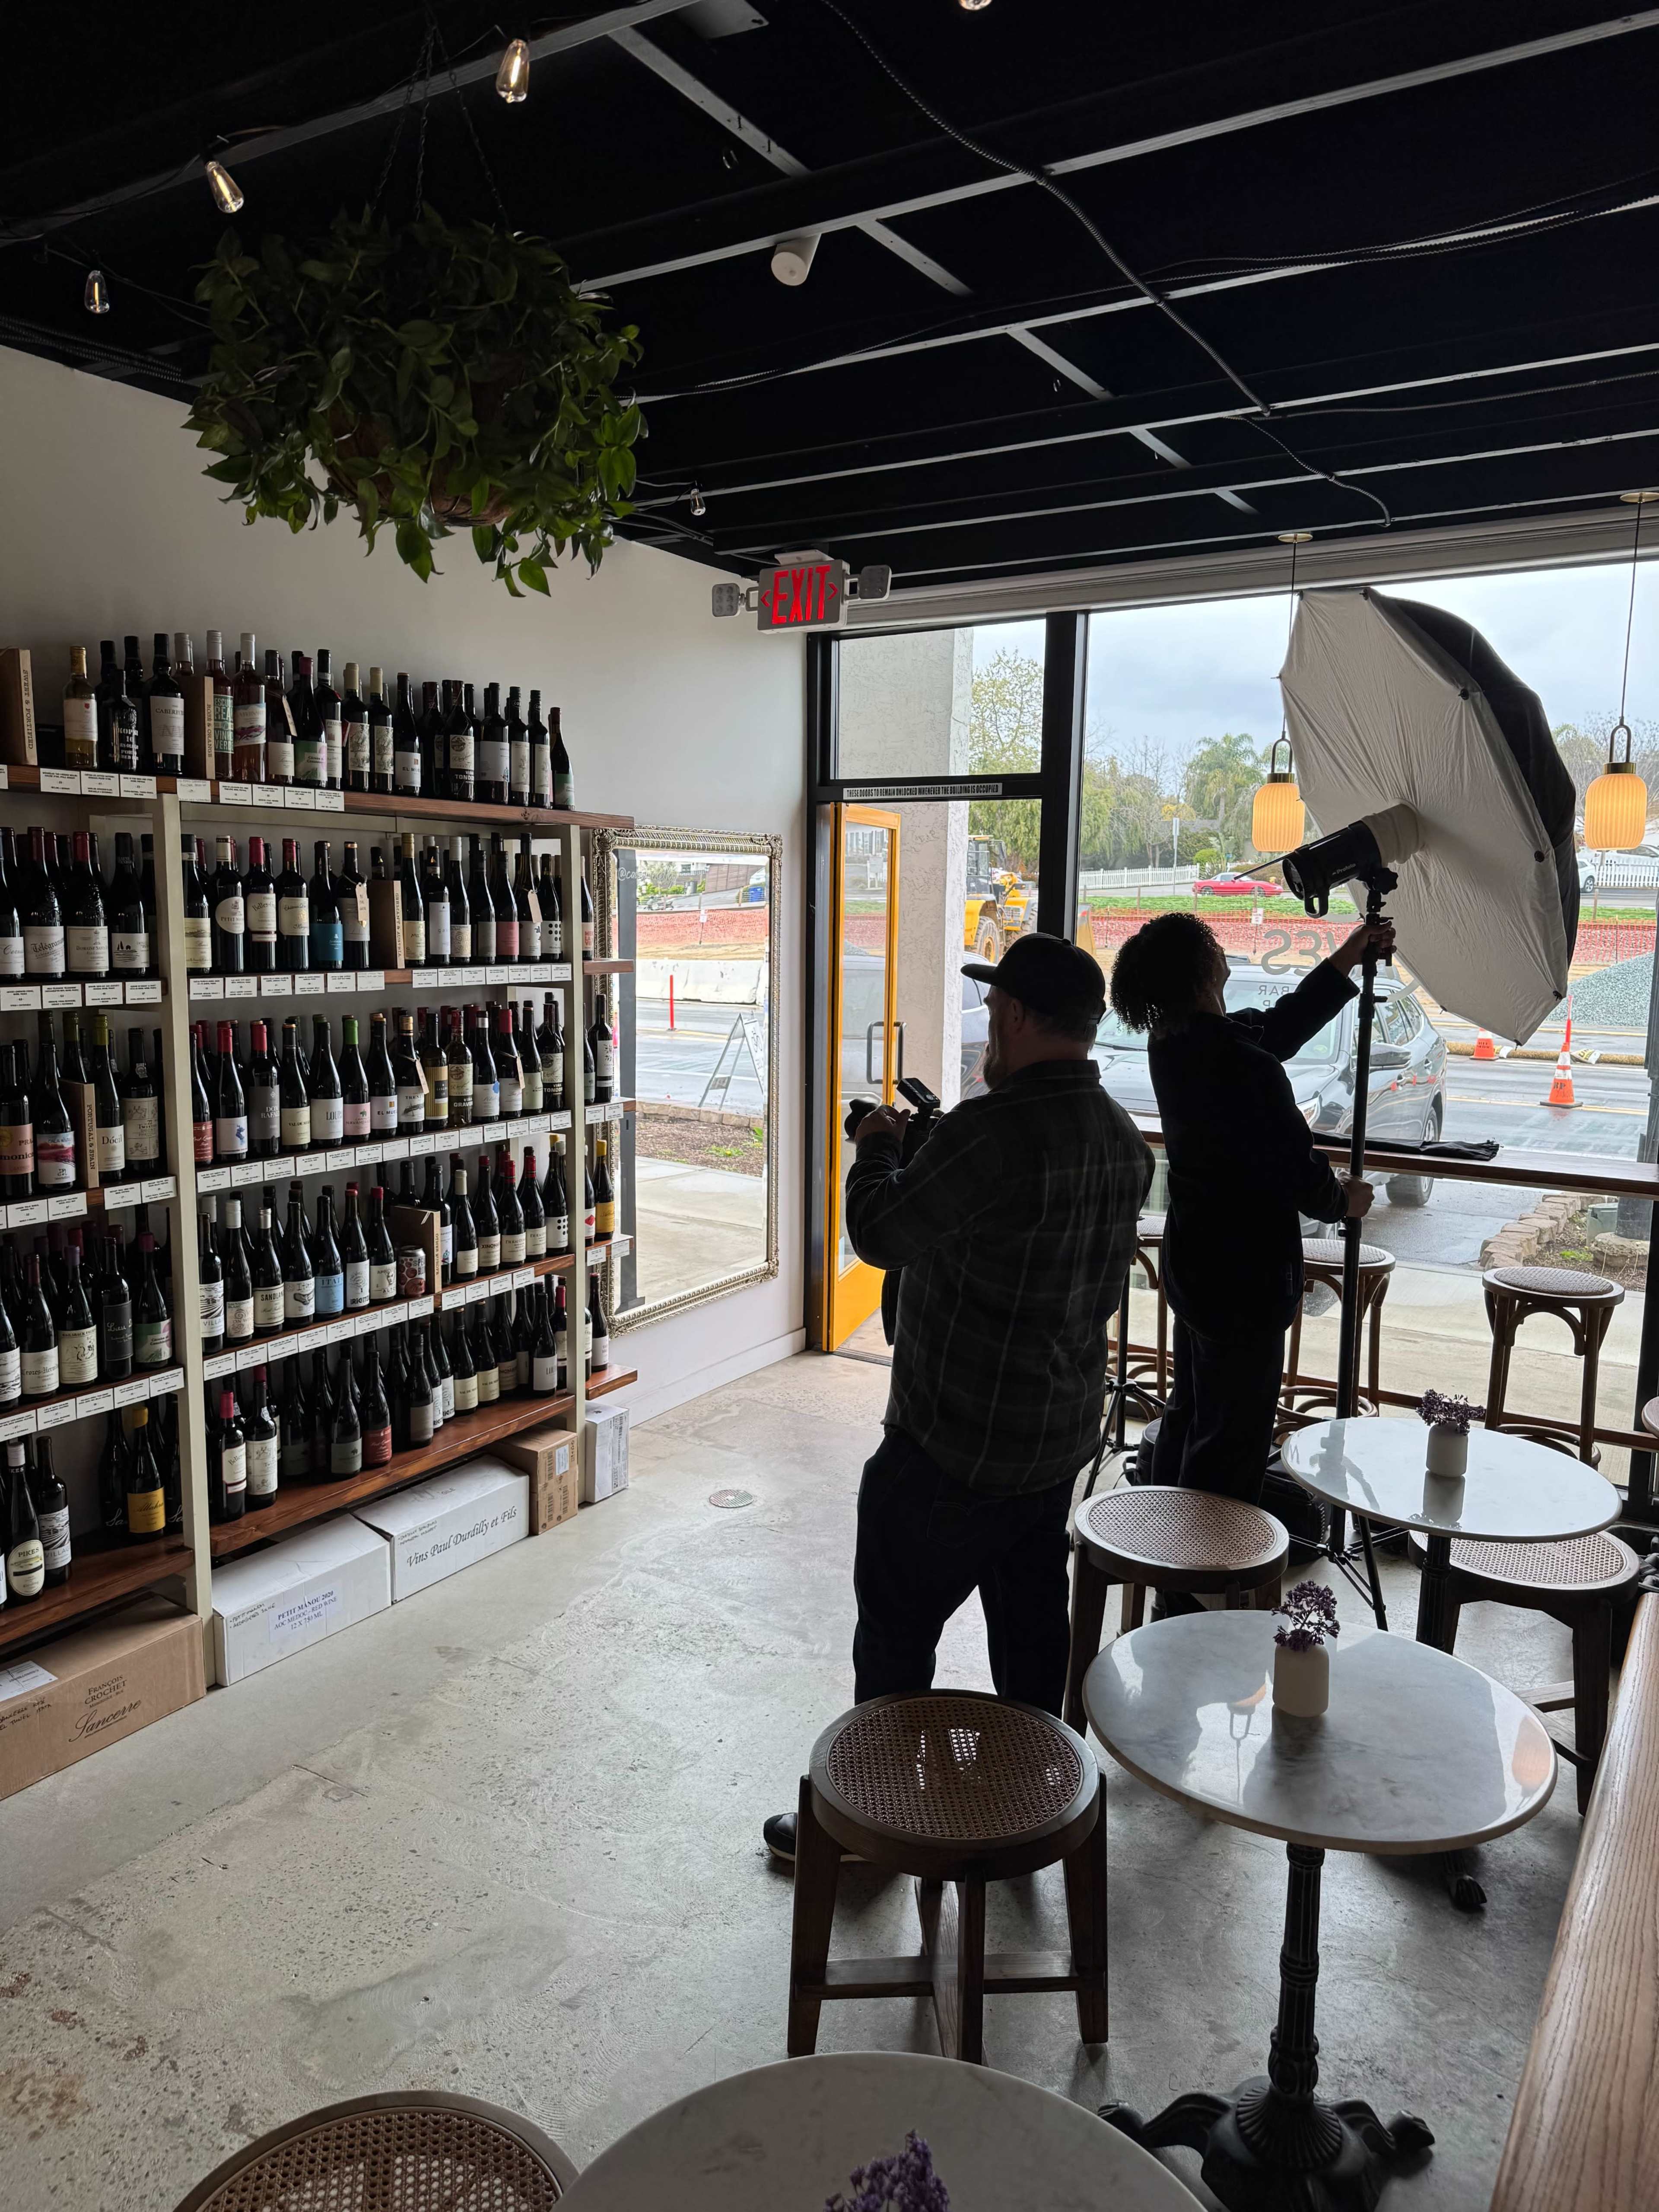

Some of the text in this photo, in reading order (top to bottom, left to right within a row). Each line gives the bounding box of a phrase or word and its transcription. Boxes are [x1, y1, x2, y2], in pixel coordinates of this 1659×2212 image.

[772, 564, 832, 625] EXIT
[860, 789, 873, 797] DOORS
[880, 788, 895, 796] REMAIN
[896, 787, 917, 796] UNLOCKED
[918, 786, 941, 795] WHENEVER
[950, 785, 970, 794] BUILDING
[976, 784, 999, 793] OCCUPIED
[102, 1134, 122, 1145] Dócil
[407, 1549, 429, 1567] Vins
[430, 1535, 453, 1557] Paul
[454, 1519, 489, 1545] Durdilly
[491, 1516, 499, 1528] et
[501, 1506, 517, 1523] Fils
[18, 1547, 39, 1558] PIKES
[274, 1620, 287, 1630] AOC
[287, 1612, 308, 1626] MEDOC
[311, 1604, 322, 1614] RED
[324, 1596, 338, 1607] WINE
[278, 1607, 297, 1620] PETIT
[298, 1597, 321, 1610] MANOU
[322, 1590, 334, 1601] 2020
[304, 1616, 314, 1625] 750
[313, 1611, 323, 1620] ML
[85, 1679, 127, 1705] CROCHET
[88, 1674, 124, 1695] FRANÇOIS
[68, 1700, 141, 1742] Sancerre
